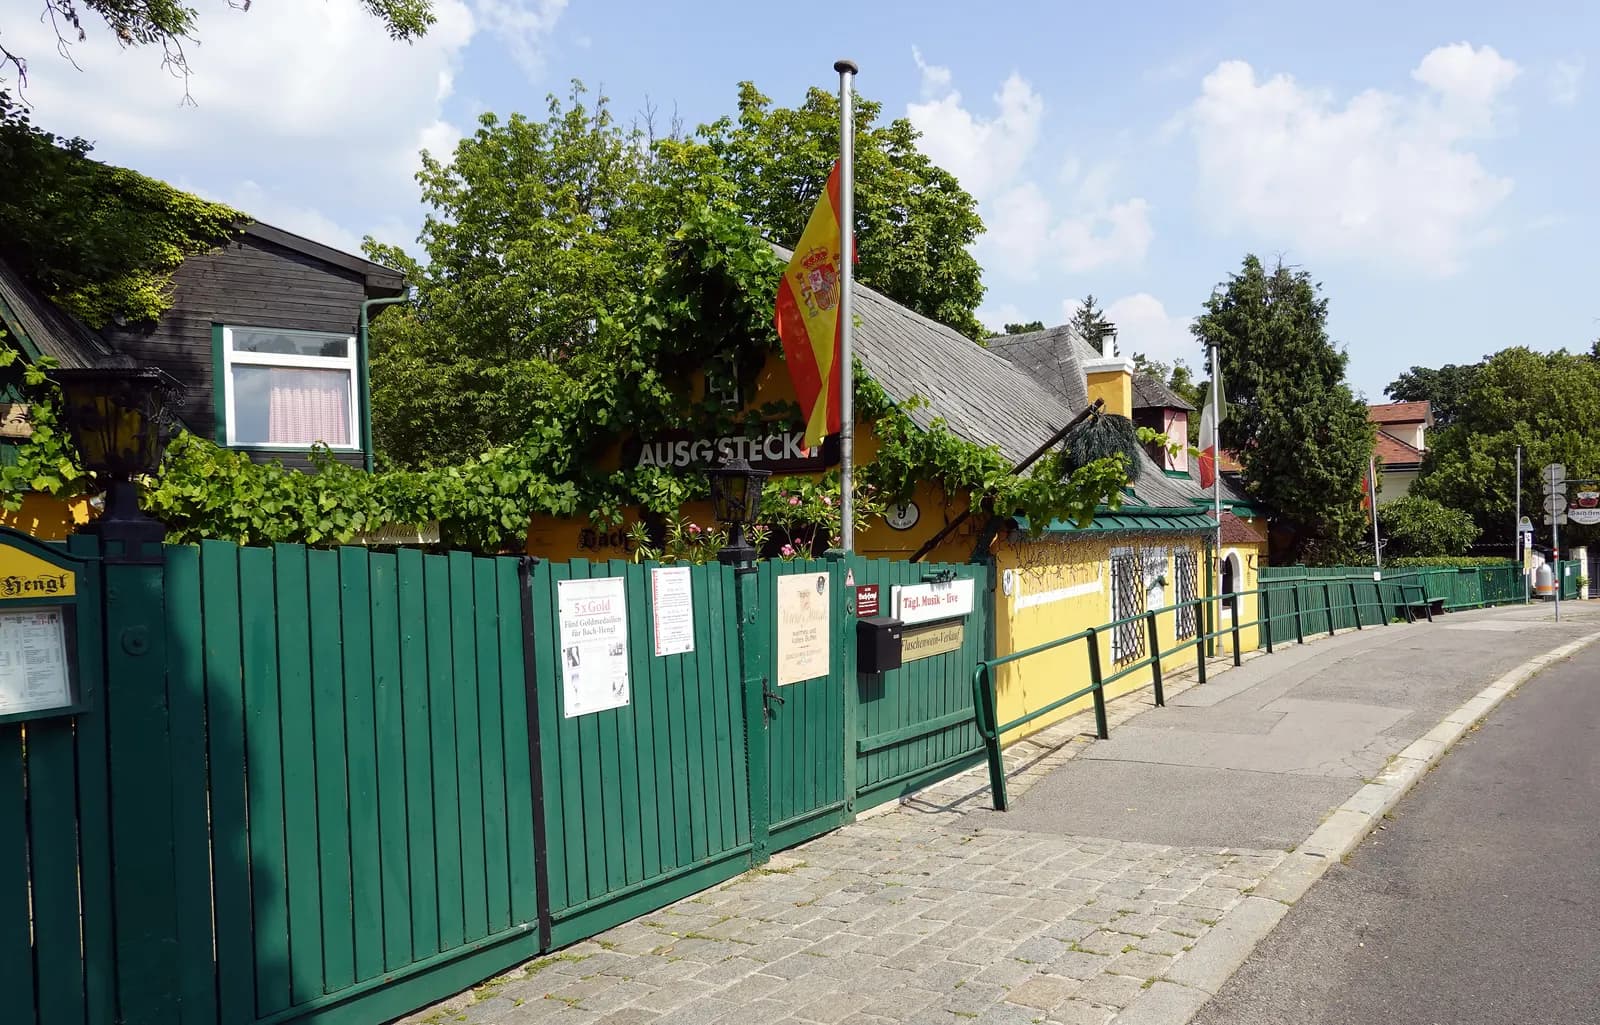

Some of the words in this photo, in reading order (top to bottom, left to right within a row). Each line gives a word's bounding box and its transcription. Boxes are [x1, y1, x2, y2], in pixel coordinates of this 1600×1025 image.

[639, 431, 819, 468] AUSG'STECK
[1, 574, 69, 597] Hengl
[588, 599, 611, 612] Gold
[903, 596, 921, 610] Tägl.
[921, 594, 941, 607] Musik
[564, 618, 579, 629] Fünf
[579, 615, 622, 627] Goldmedaillen
